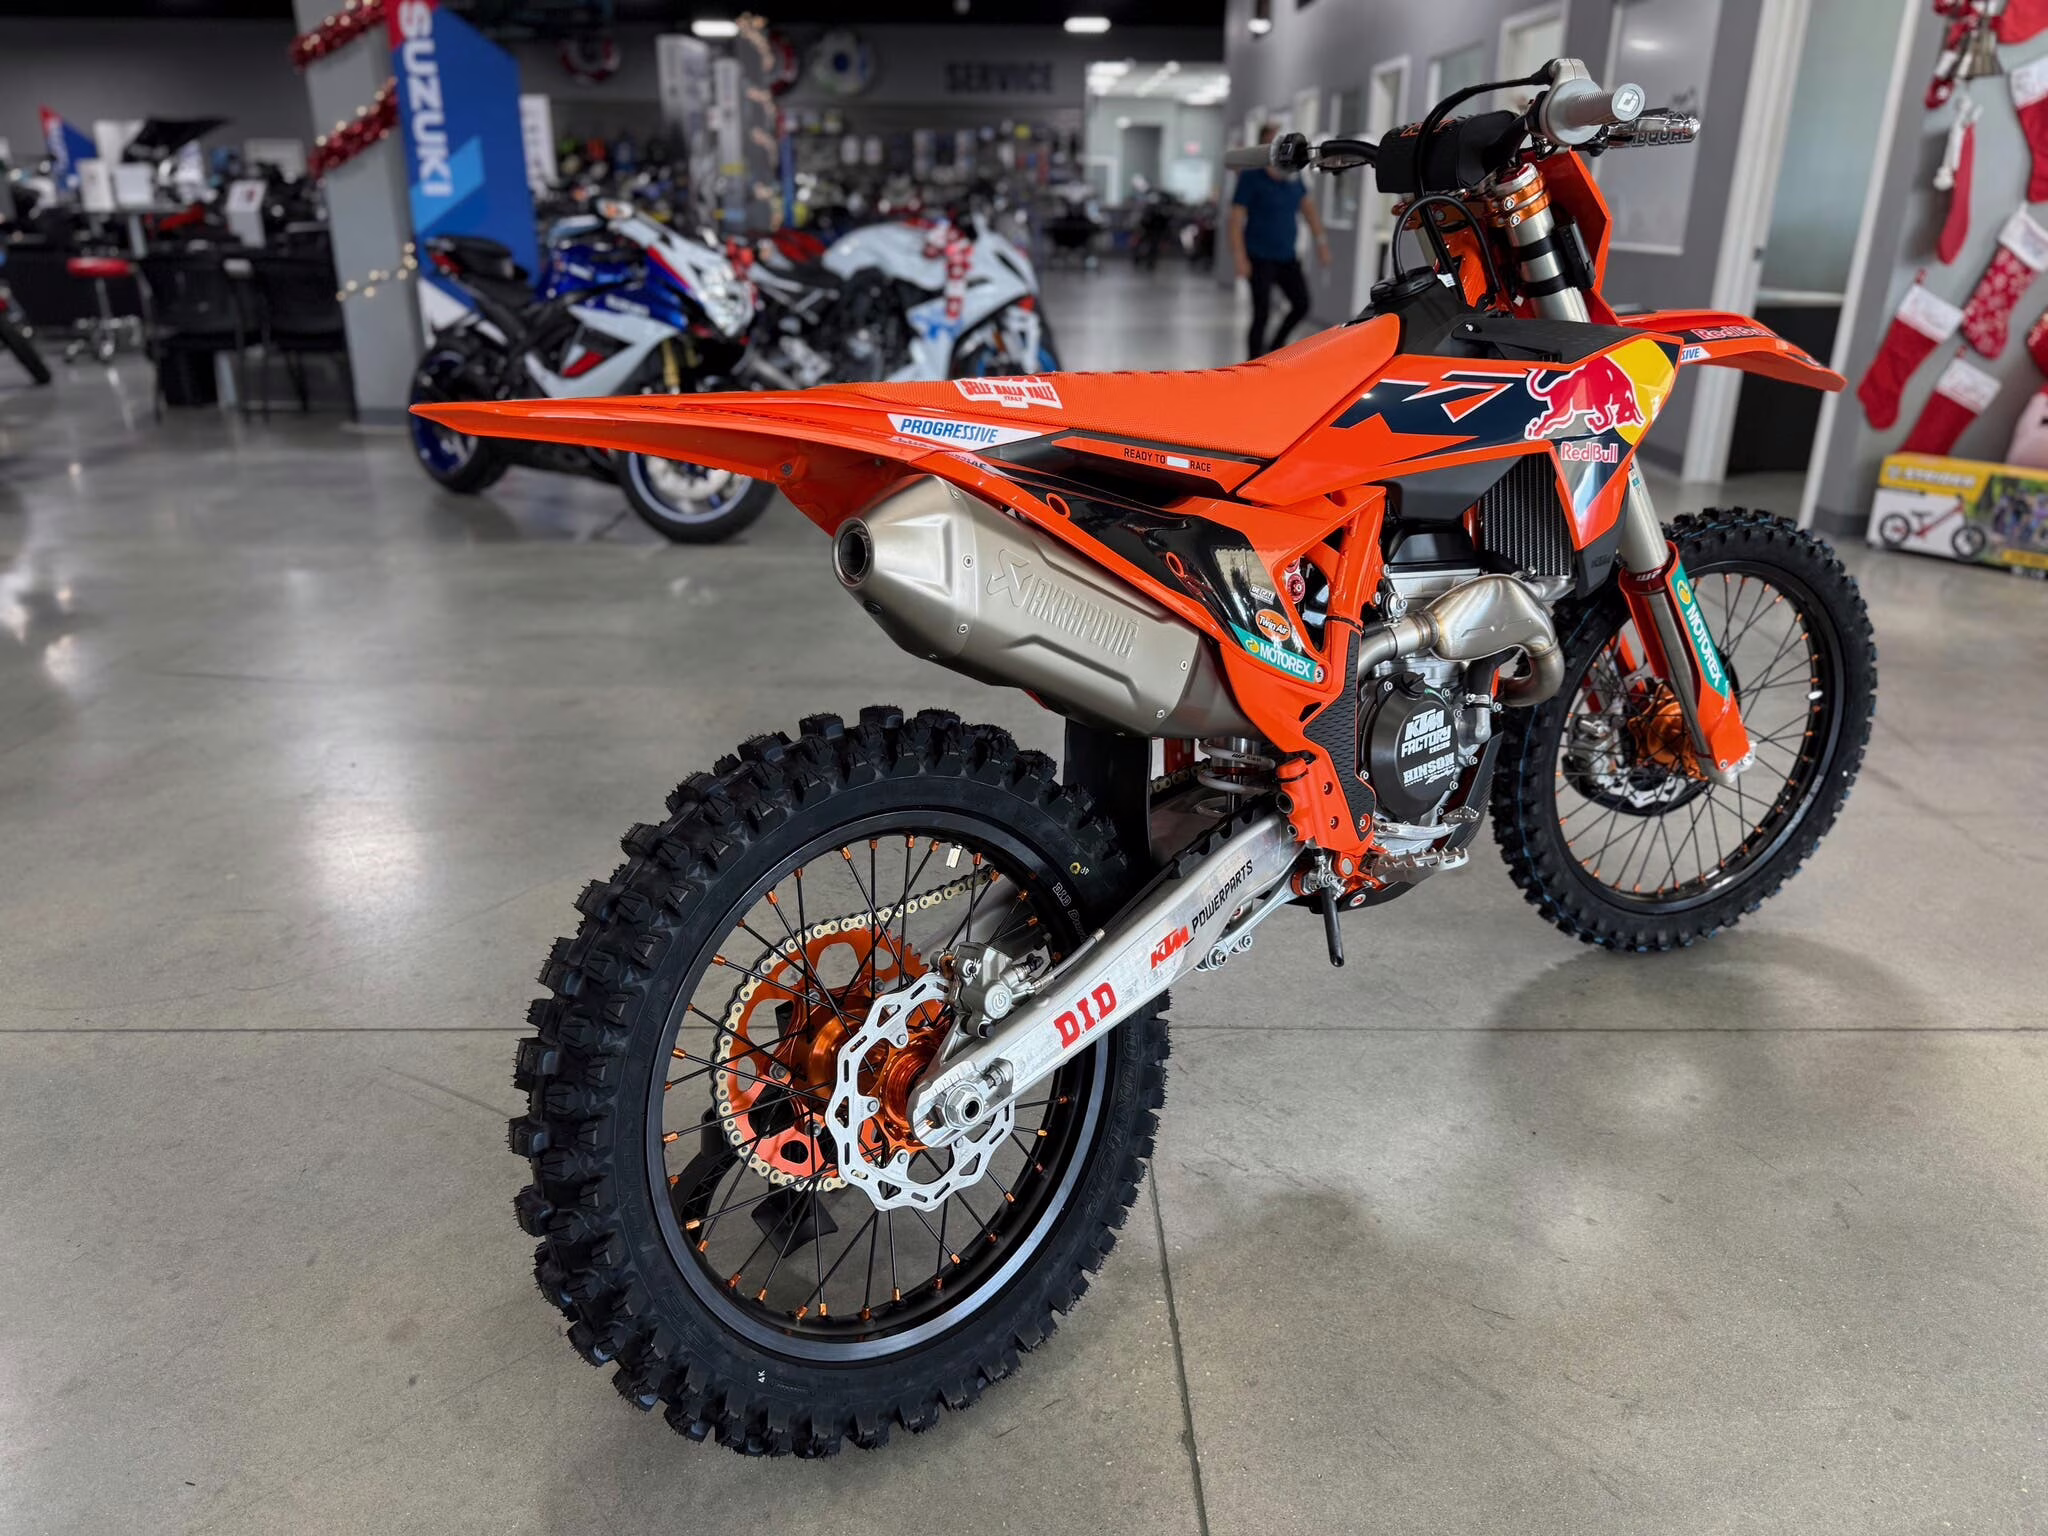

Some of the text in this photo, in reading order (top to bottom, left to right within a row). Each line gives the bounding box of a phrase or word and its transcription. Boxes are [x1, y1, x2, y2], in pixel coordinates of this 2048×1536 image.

[398, 0, 453, 196] SUZUKI
[900, 418, 998, 444] PROGRESSIVE
[1124, 447, 1211, 472] READY TO RACE
[1561, 441, 1618, 463] Red Bull
[1259, 615, 1289, 635] Twin Air
[1260, 642, 1312, 678] MOTOREX
[1686, 602, 1722, 688] MOTOREX
[1405, 709, 1444, 741] KTM
[1401, 725, 1452, 758] FACTORY
[1403, 752, 1455, 784] HINSON
[1151, 925, 1190, 970] KTM
